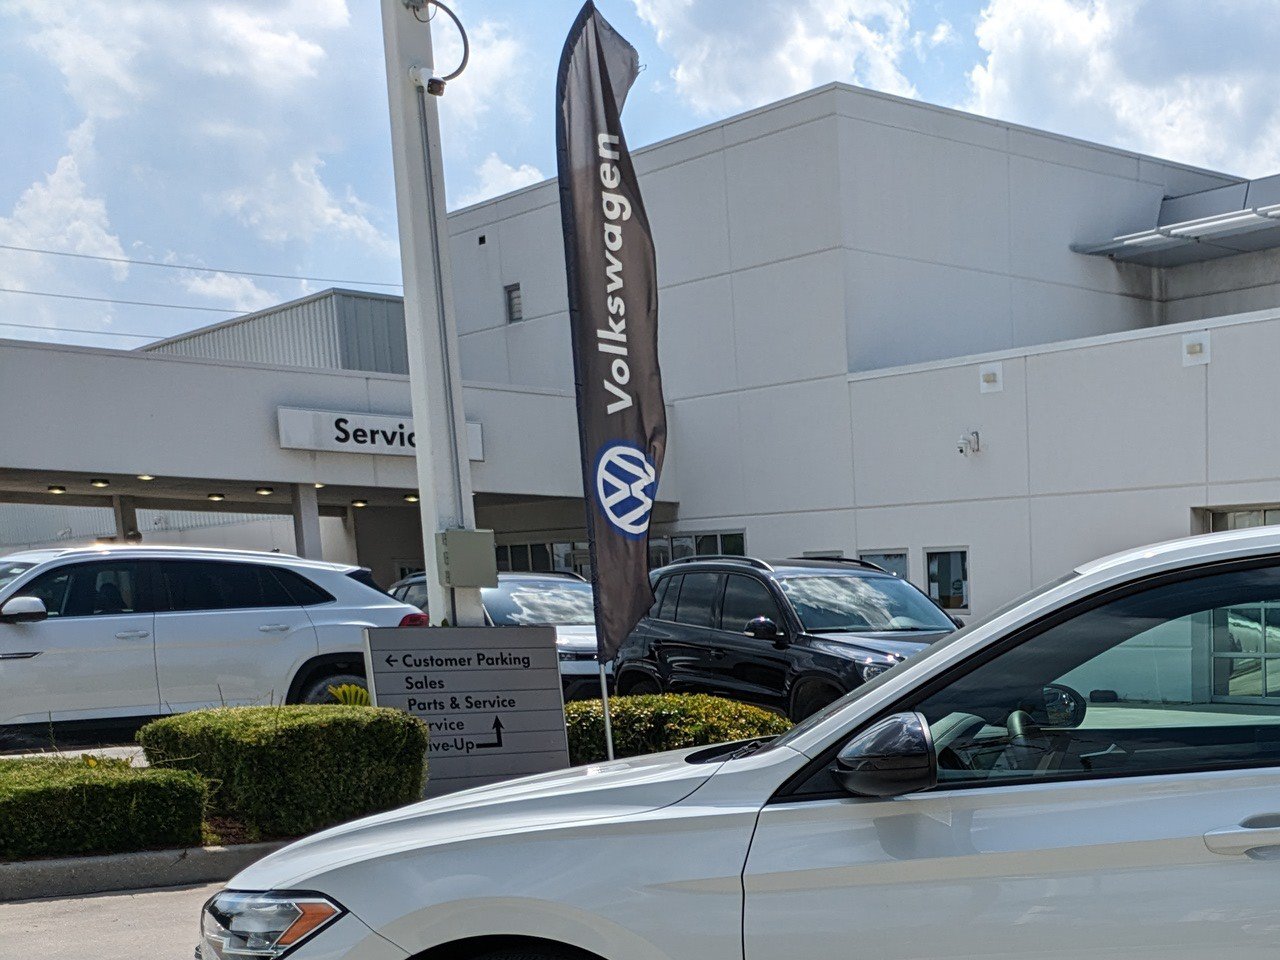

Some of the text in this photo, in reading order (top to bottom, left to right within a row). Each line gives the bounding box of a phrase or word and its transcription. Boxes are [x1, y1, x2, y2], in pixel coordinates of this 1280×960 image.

[597, 133, 634, 415] Volkswagen
[334, 417, 416, 448] Servic
[402, 652, 531, 669] Customer Parking
[405, 675, 445, 690] Sales
[407, 695, 516, 711] Parts & Service
[428, 717, 465, 731] rvice
[428, 737, 475, 754] ive-Up
